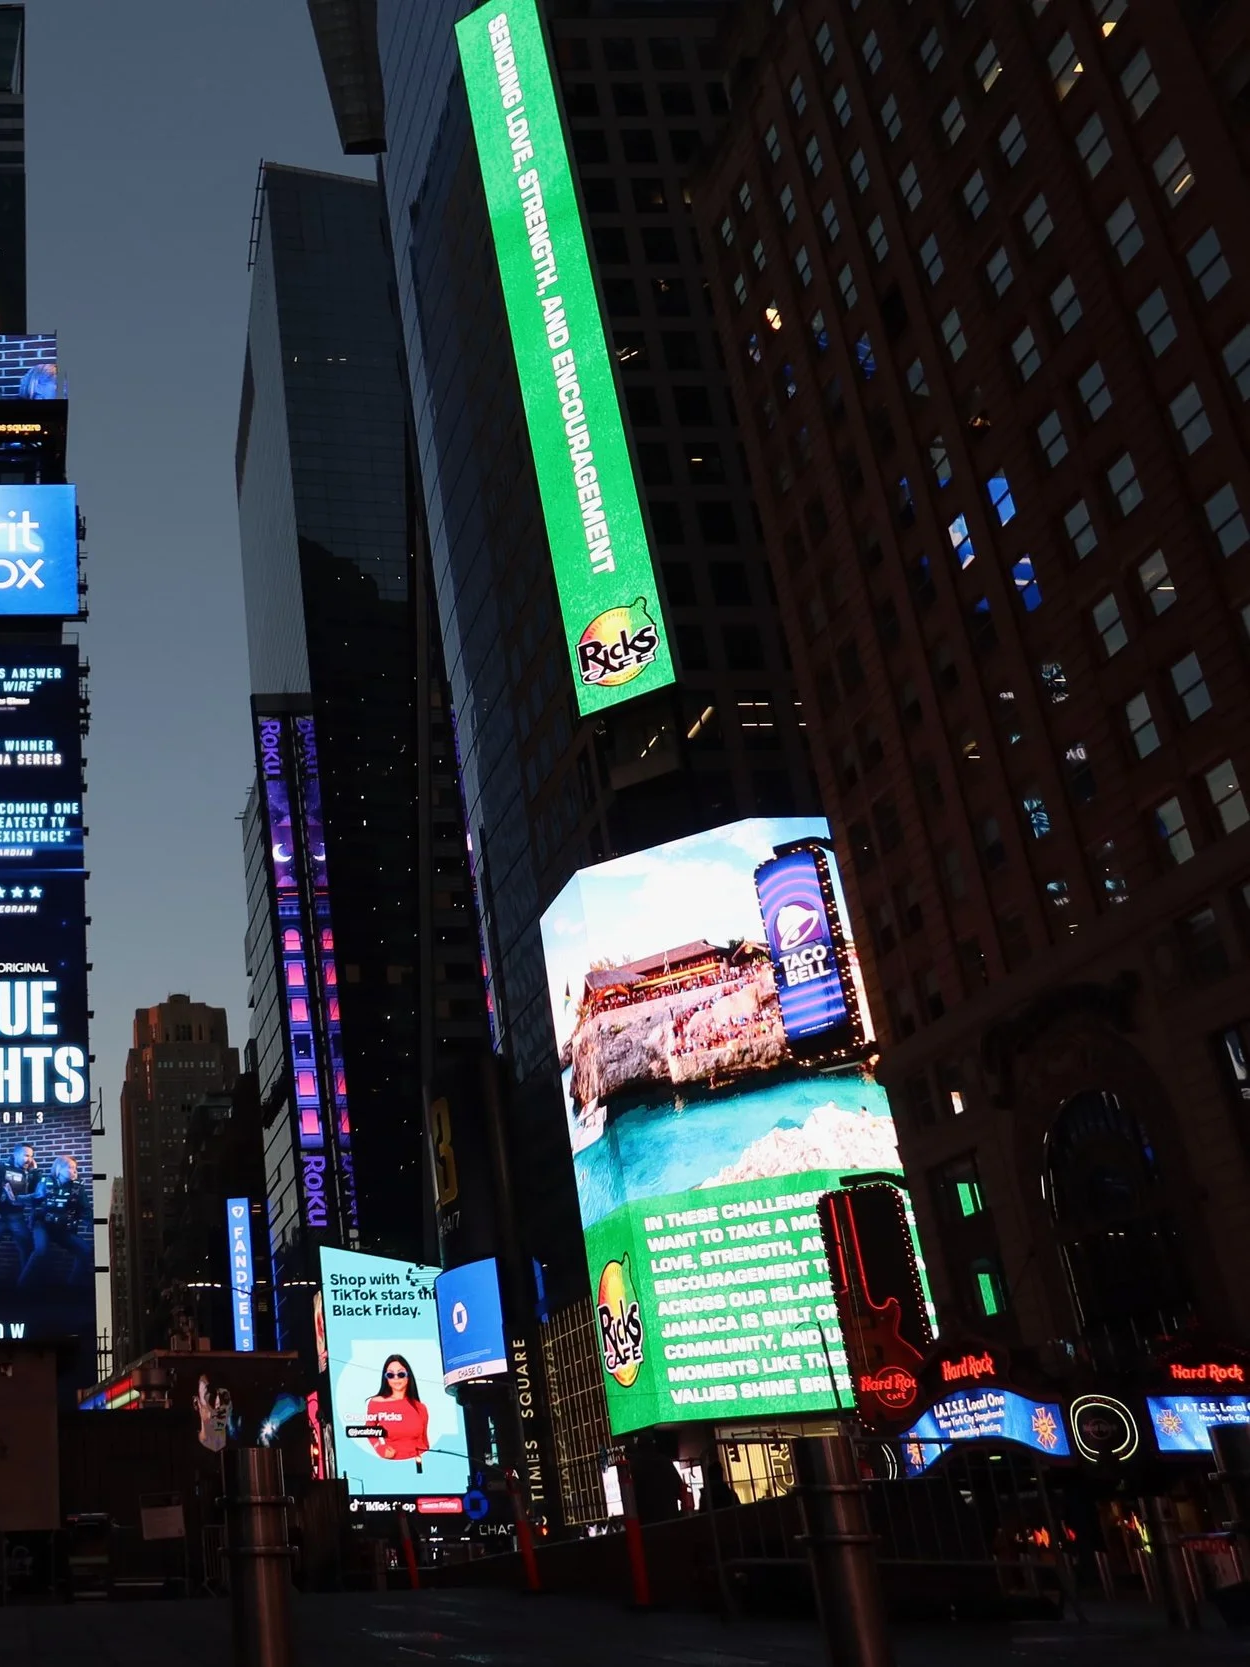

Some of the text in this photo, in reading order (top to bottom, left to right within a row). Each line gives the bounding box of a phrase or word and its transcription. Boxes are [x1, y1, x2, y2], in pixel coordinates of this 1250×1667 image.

[487, 12, 524, 109] SENDING
[505, 105, 535, 173] LOVE,
[517, 168, 558, 297] STRENGTH,
[541, 295, 570, 350] AND
[7, 424, 41, 434] square
[550, 349, 616, 575] ENCOURAGEMENT
[11, 668, 61, 679] ANSWER
[3, 681, 42, 692] WIRE"
[6, 697, 30, 705] Times
[5, 740, 53, 751] WINNER
[260, 720, 281, 775] ROKU
[17, 754, 62, 765] SERIES
[54, 803, 79, 814] ONE
[51, 817, 66, 828] TV
[780, 945, 828, 973] TACO
[785, 961, 831, 987] BELL
[36, 1111, 44, 1123] 3
[302, 1155, 327, 1227] ROKU
[644, 1215, 663, 1231] IN
[666, 1207, 719, 1228] THESE
[647, 1232, 698, 1252] WANT
[700, 1228, 724, 1244] TO
[726, 1221, 771, 1239] TAKE
[774, 1218, 788, 1233] A
[651, 1253, 698, 1273] LOVE,
[700, 1240, 798, 1267] STRENGTH,
[234, 1227, 249, 1331] FANDUEL
[330, 1272, 400, 1288] Shop with
[654, 1262, 810, 1295] ENCOURAGEMENT
[331, 1289, 377, 1301] TikTok
[381, 1290, 415, 1301] stars
[658, 1294, 727, 1316] ACROSS
[729, 1289, 768, 1306] OUR
[332, 1305, 421, 1318] Black Friday.
[661, 1315, 738, 1338] JAMAICA
[741, 1312, 759, 1328] IS
[762, 1306, 812, 1326] BUILT
[664, 1327, 843, 1360] COMMUNITY, AND U
[606, 1347, 643, 1370] CAFE
[667, 1358, 759, 1382] MOMENTS
[762, 1353, 802, 1372] LIKE
[942, 1352, 995, 1381] Hard Rock
[458, 1367, 476, 1378] CHASE
[1170, 1363, 1245, 1382] Hard Rock
[670, 1384, 738, 1405] VALUES
[740, 1379, 797, 1398] SHINE
[861, 1376, 892, 1392] Hard
[886, 1392, 907, 1401] CAFE
[967, 1394, 987, 1411] Local
[988, 1393, 1005, 1406] One
[378, 1412, 403, 1421] Picks
[1175, 1402, 1246, 1413] I.A.T.S.E. Local
[1216, 1414, 1233, 1422] York
[1234, 1414, 1250, 1422] City
[513, 1338, 545, 1502] TIMES SQUARE
[939, 1408, 1005, 1429] New York City Stagehands
[980, 1422, 1001, 1433] Meeting
[392, 1501, 416, 1512] Sop
